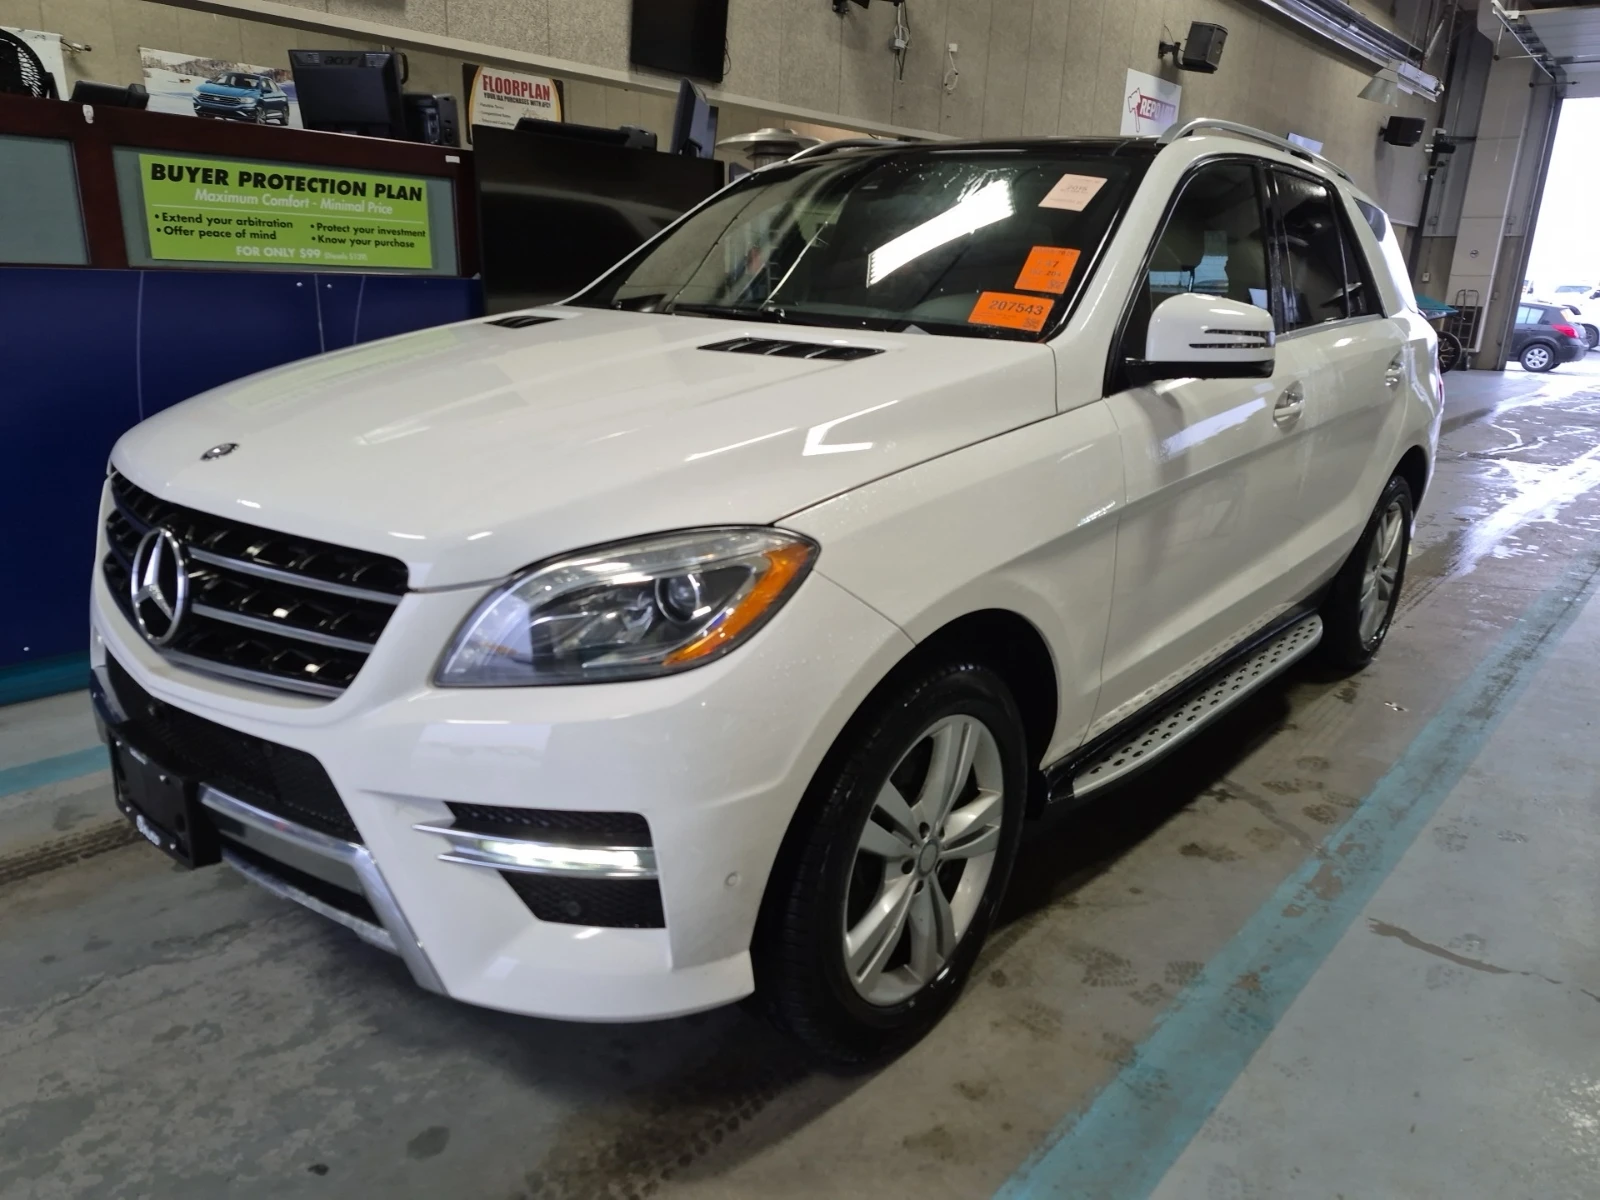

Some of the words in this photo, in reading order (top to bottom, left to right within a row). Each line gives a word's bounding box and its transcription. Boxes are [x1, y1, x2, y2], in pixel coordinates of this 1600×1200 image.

[482, 74, 551, 101] FLOORPLAN
[504, 95, 530, 106] PURCHASES
[1139, 97, 1161, 120] REPO
[151, 162, 229, 186] BUYER
[238, 170, 367, 197] PROTECTION
[374, 183, 423, 202] PLAN
[194, 188, 259, 205] Maximum
[262, 193, 310, 208] Comfort
[320, 198, 365, 213] Minimal
[367, 201, 393, 215] Price
[162, 212, 203, 224] Extend
[206, 216, 233, 227] your
[236, 215, 294, 229] arbitration
[163, 225, 195, 236] Offer
[198, 228, 232, 239] peace
[235, 228, 248, 239] of
[249, 229, 277, 240] mind
[316, 222, 351, 233] Protect
[353, 226, 375, 236] your
[377, 225, 427, 237] investment
[317, 234, 347, 245] Know
[349, 237, 372, 247] your
[374, 238, 416, 249] purchase
[235, 245, 261, 257] FOR
[263, 246, 296, 258] ONLY
[300, 247, 322, 260] $99
[988, 299, 1044, 316] 207543
